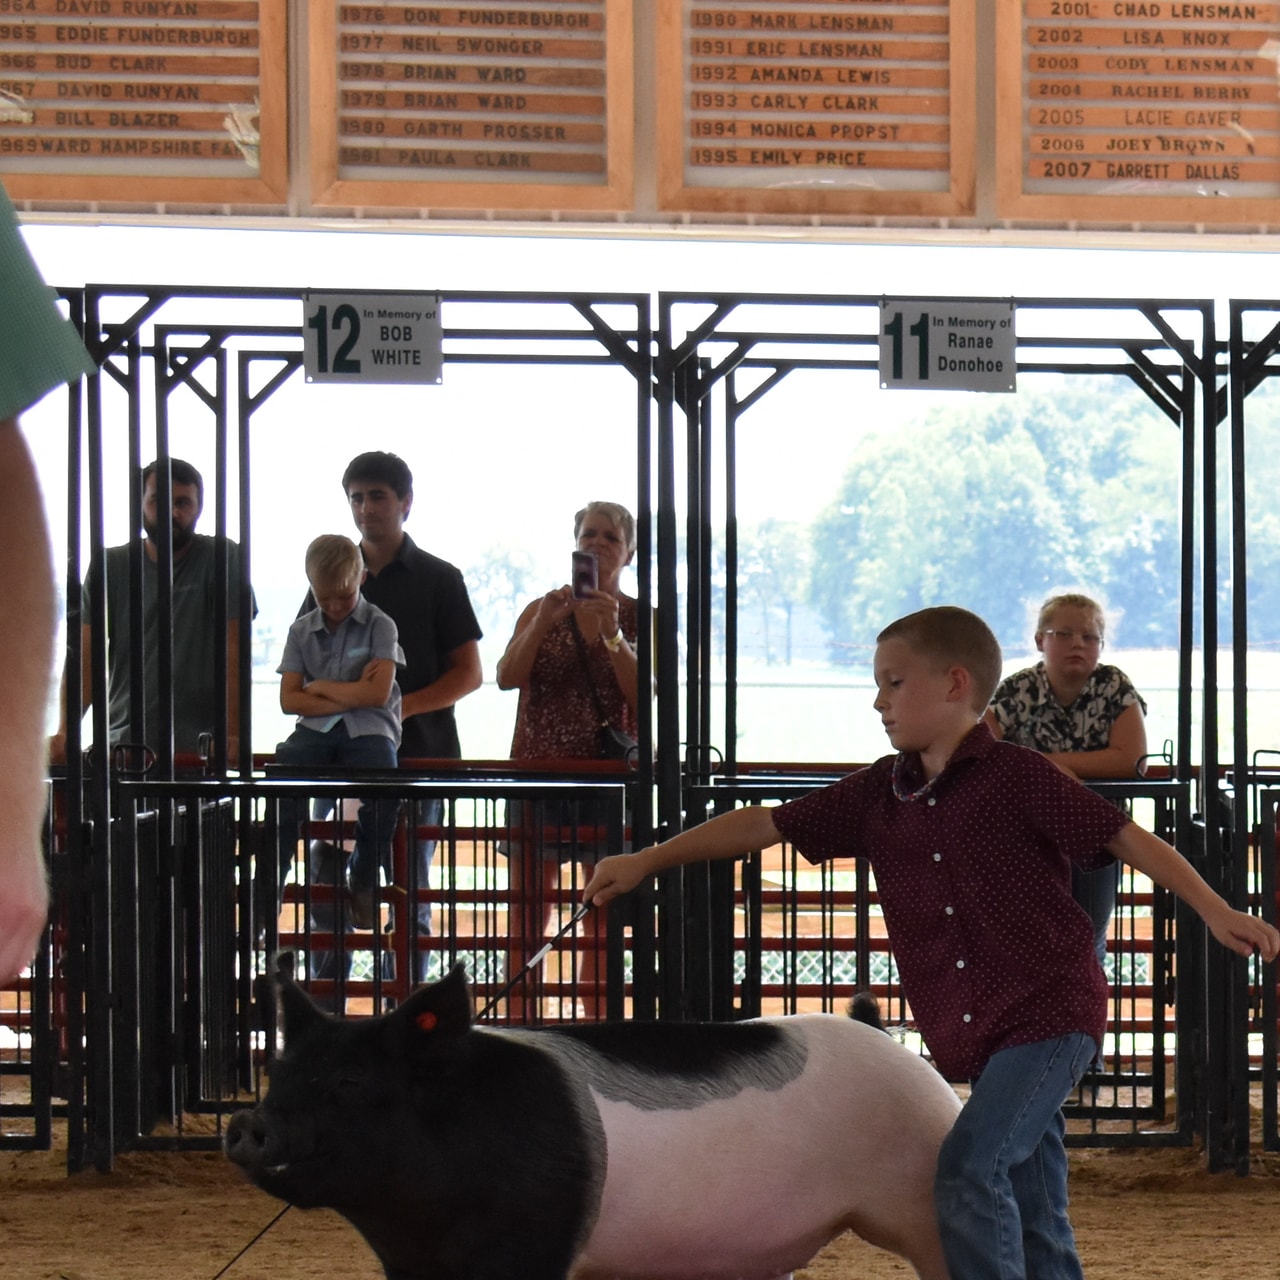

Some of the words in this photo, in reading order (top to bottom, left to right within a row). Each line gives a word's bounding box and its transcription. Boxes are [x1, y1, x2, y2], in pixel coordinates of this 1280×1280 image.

[55, 0, 112, 14] DAVID
[122, 0, 199, 16] RUNYAN
[1051, 1, 1091, 16] 2001
[1113, 3, 1161, 18] CHAD
[1171, 4, 1256, 20] LENSMAN
[341, 8, 385, 22] 1976
[403, 10, 441, 24] DON
[458, 11, 590, 27] FUNDERBURGH
[695, 13, 737, 27] 1990
[750, 14, 799, 29] MARK
[809, 15, 894, 31] LENSMAN
[55, 26, 109, 42] EDDIE
[117, 28, 250, 44] FUNDERBURGH
[1037, 29, 1084, 43] 2002
[1123, 31, 1165, 45] LISA
[1182, 32, 1231, 46] KNOX
[341, 35, 384, 49] 1977
[402, 37, 442, 51] NEIL
[456, 39, 544, 54] SWONGER
[695, 41, 733, 55] 1991
[746, 42, 786, 56] ERIC
[799, 43, 884, 58] LENSMAN
[55, 55, 92, 71] BUD
[108, 56, 168, 72] CLARK
[1037, 57, 1079, 70] 2003
[1105, 57, 1149, 71] CODY
[1164, 59, 1255, 72] LENSMAN
[403, 65, 458, 80] BRIAN
[475, 67, 527, 83] WARD
[695, 67, 738, 81] 1992
[750, 68, 824, 83] AMANDA
[837, 69, 892, 84] LEWIS
[56, 84, 113, 98] DAVID
[124, 84, 200, 100] RUNYAN
[1039, 84, 1081, 97] 2004
[1111, 85, 1184, 99] RACHEL
[1193, 86, 1252, 99] BERRY
[403, 93, 459, 108] BRIAN
[477, 94, 527, 110] WARD
[695, 94, 738, 108] 1993
[750, 94, 809, 109] CARLY
[823, 96, 880, 111] CLARK
[55, 111, 96, 126] BILL
[108, 112, 180, 127] BLAZER
[1039, 109, 1085, 125] 2005
[1124, 110, 1173, 125] LACIE
[1184, 111, 1242, 126] GAVER
[341, 121, 385, 135] 1980
[404, 122, 463, 137] GARTH
[483, 124, 567, 140] PROSSER
[695, 123, 738, 136] 1994
[750, 124, 817, 138] MONICA
[39, 140, 91, 154] WARD
[1041, 138, 1085, 151] 2006
[1106, 139, 1152, 151] JOEY
[1160, 139, 1226, 152] BROWN
[399, 150, 456, 165] PAULA
[473, 152, 531, 168] CLARK
[695, 149, 738, 164] 1995
[750, 150, 802, 165] EMILY
[815, 152, 867, 166] PRICE
[1044, 163, 1092, 178] 2007
[1106, 163, 1170, 179] GARRETT
[1185, 164, 1240, 180] DALLAS
[363, 309, 374, 318] In
[378, 309, 422, 320] Memory
[425, 310, 436, 319] of
[933, 316, 944, 327] In
[948, 316, 996, 330] Memory
[999, 318, 1012, 328] of
[308, 303, 361, 373] 12
[380, 326, 412, 341] BOB
[948, 332, 994, 349] Ranae
[884, 312, 929, 380] 11
[372, 349, 421, 365] WHITE
[938, 356, 1003, 372] Donohoe
